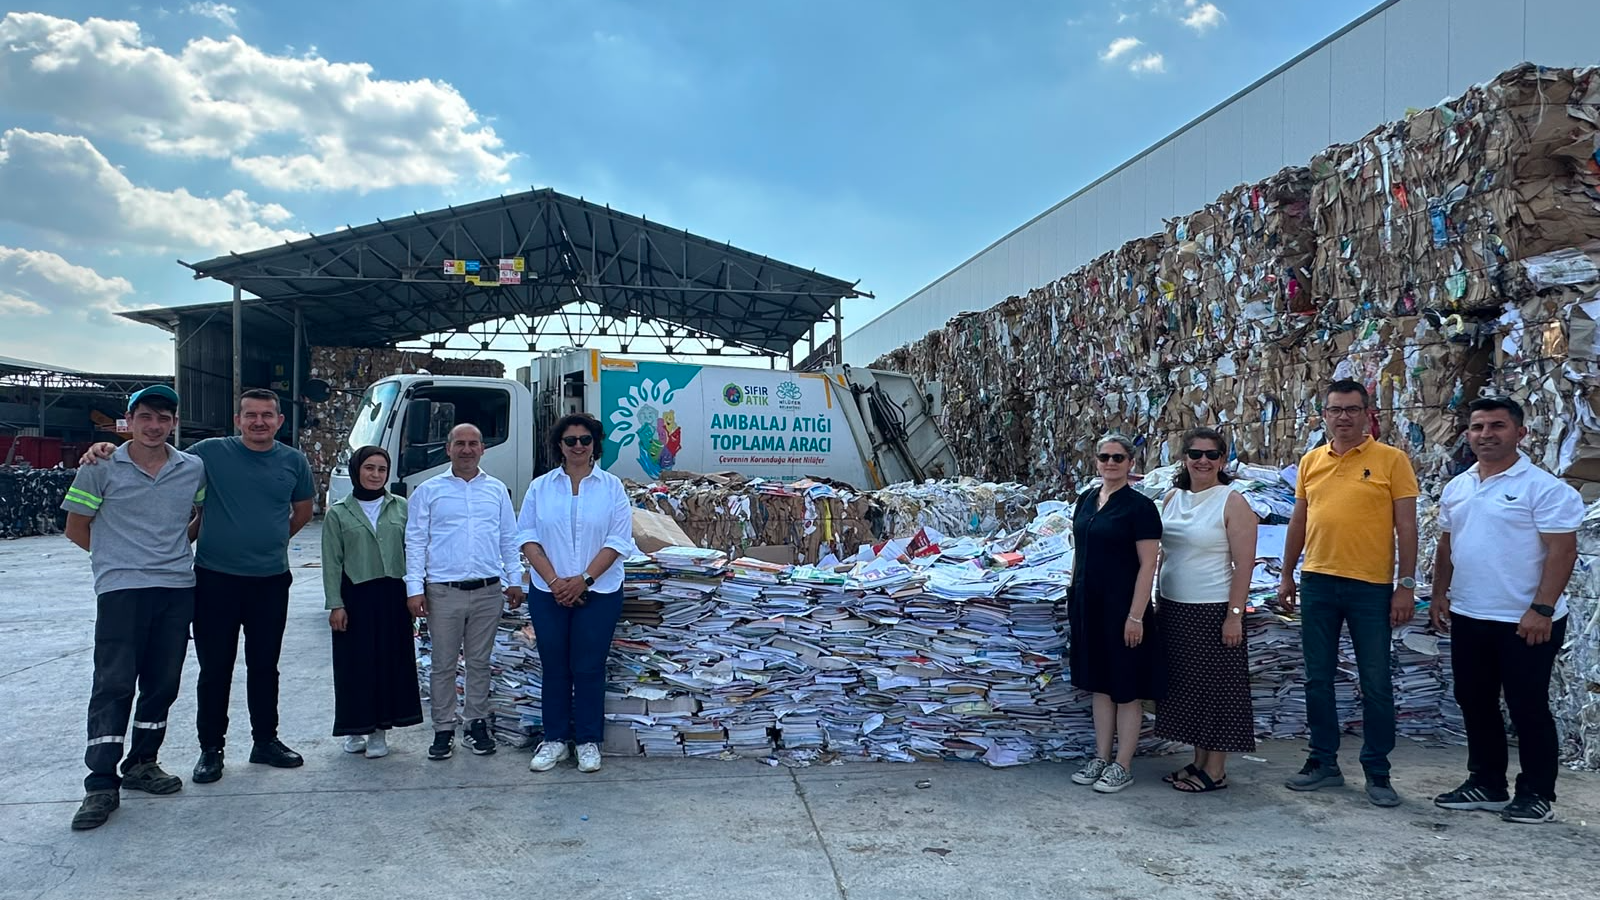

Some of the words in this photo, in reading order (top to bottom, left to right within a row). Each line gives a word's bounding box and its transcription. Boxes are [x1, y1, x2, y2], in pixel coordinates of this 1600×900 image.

[744, 386, 768, 395] SIFIR
[746, 396, 769, 406] ATIK
[711, 413, 787, 431] AMBALAJ
[793, 414, 831, 433] ATIĞI
[711, 434, 785, 451] TOPLAMA
[789, 435, 831, 452] ARACI
[719, 455, 748, 464] Çevrenin
[750, 456, 786, 464] Korunduğu
[803, 456, 825, 464] Nilüfer
